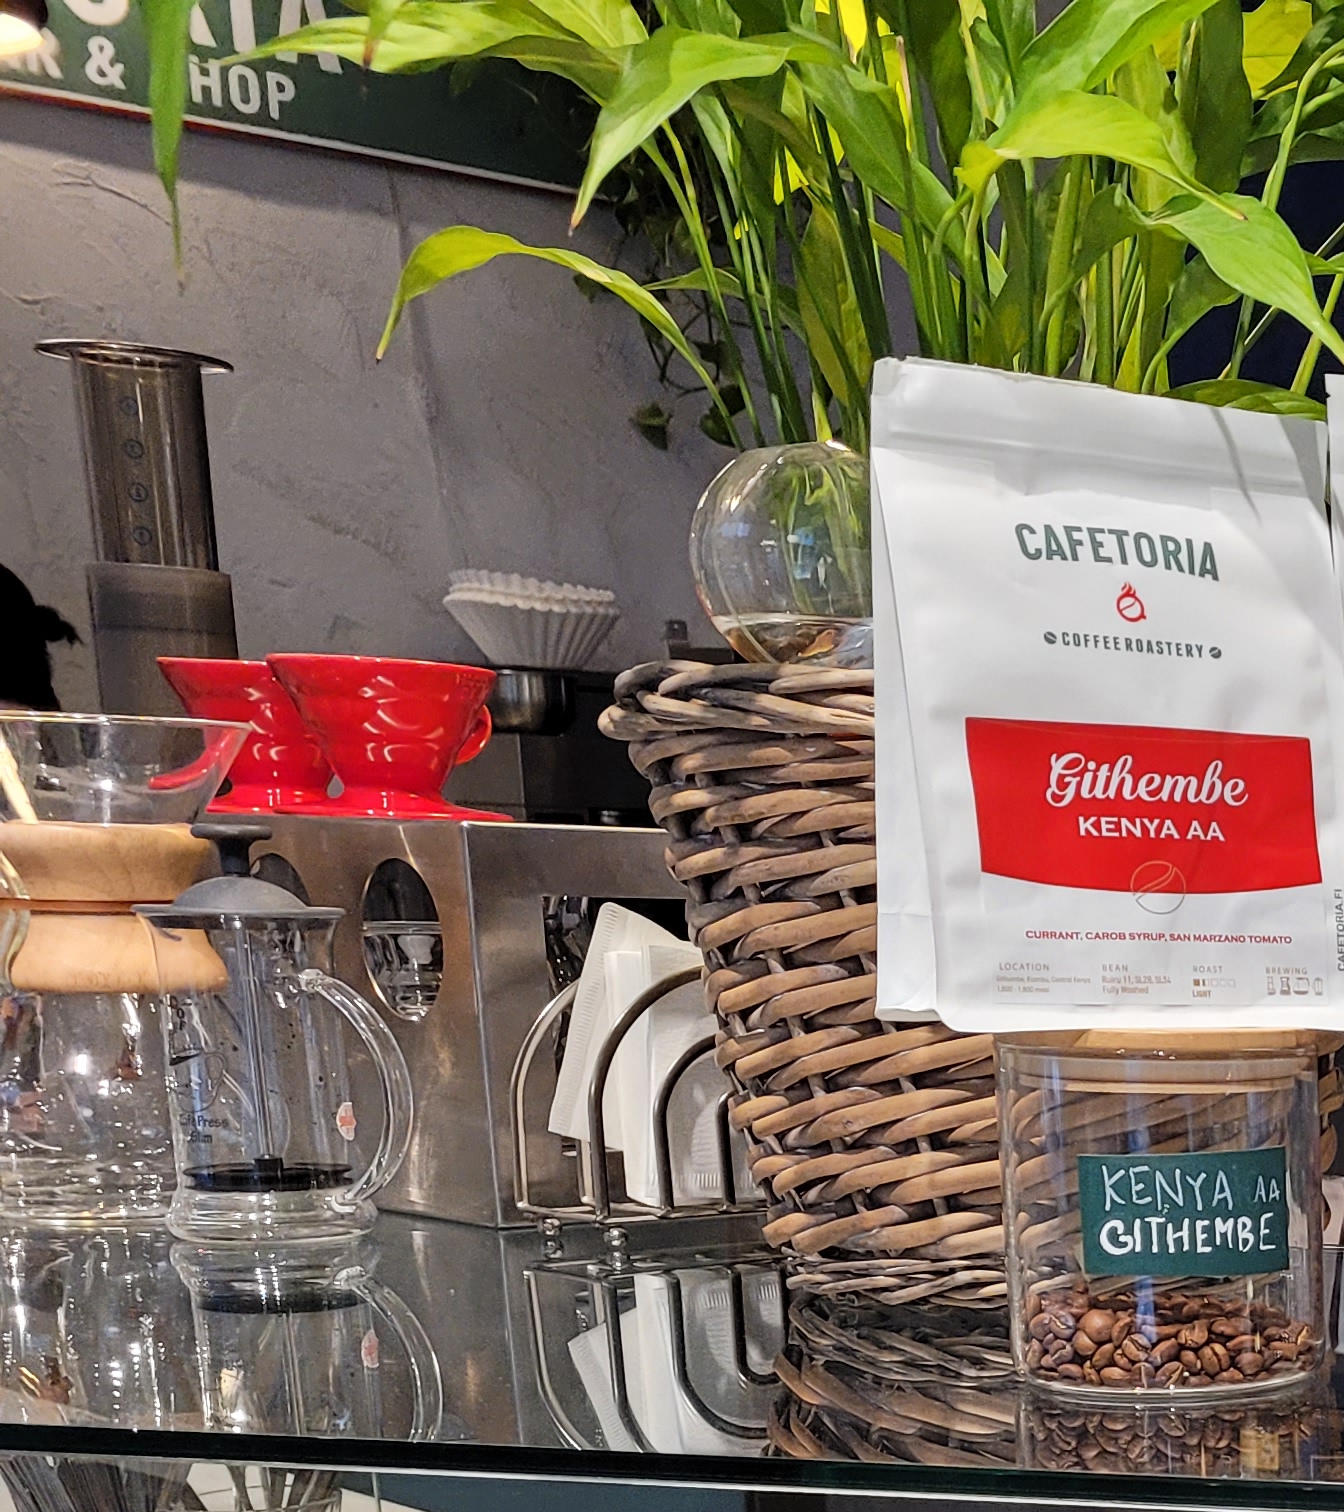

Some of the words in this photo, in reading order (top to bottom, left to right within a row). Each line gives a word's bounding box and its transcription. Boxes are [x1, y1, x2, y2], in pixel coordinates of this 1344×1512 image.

[85, 35, 126, 90] &
[189, 54, 296, 120] HOP
[1014, 523, 1220, 582] CAFETORIA
[1061, 631, 1121, 651] COFFEE
[1124, 637, 1204, 659] ROASTERY
[1046, 752, 1249, 807] Githembe
[1078, 816, 1180, 839] KENYA
[1186, 820, 1226, 842] AA
[1025, 930, 1084, 941] CURRANT,
[1085, 931, 1126, 941] CAROB
[1128, 932, 1167, 942] SYRUP,
[1169, 933, 1190, 942] SAN
[1193, 934, 1246, 943] MARZANO
[1247, 935, 1292, 944] TOMATO
[999, 962, 1050, 972] LOCATION
[1102, 963, 1128, 972] BEAN
[1193, 965, 1222, 973] ROAST
[1265, 967, 1308, 975] BREWING
[1101, 1164, 1234, 1212] KENYA
[1253, 1175, 1281, 1203] AA
[1100, 1211, 1277, 1256] GITHEMBE
